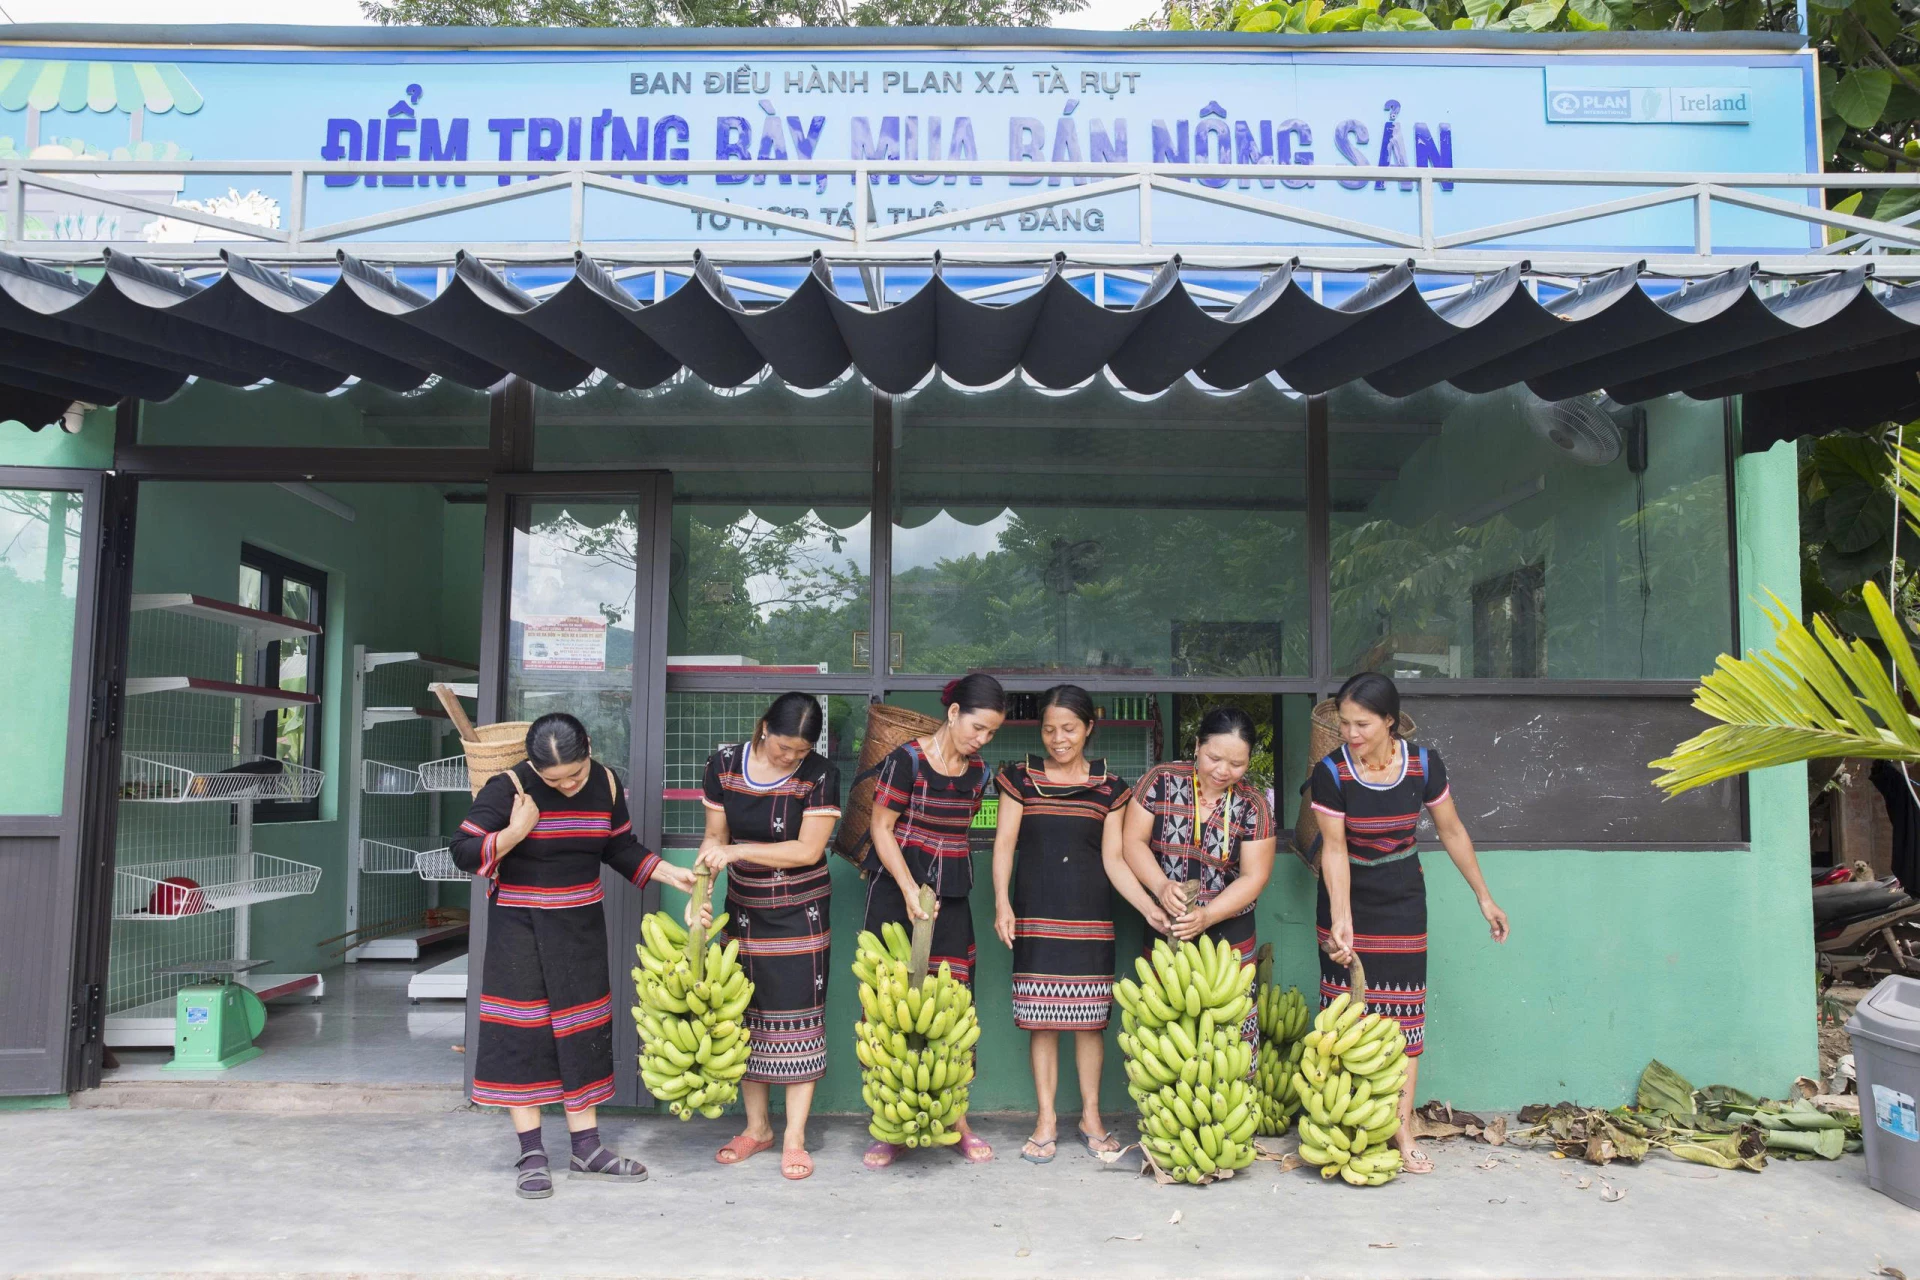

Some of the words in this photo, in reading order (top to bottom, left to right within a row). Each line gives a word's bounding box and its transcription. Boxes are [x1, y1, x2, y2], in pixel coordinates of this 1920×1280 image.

[630, 71, 692, 95] BAN
[704, 64, 771, 95] ĐIỀU
[784, 65, 868, 94] HÀNH
[883, 71, 963, 94] PLAN
[975, 65, 1019, 94] XÃ
[1032, 64, 1070, 94] TÀ
[1081, 71, 1141, 100] RỤT
[1582, 95, 1628, 109] PLAN
[1679, 92, 1747, 112] Ireland
[321, 83, 470, 188] ĐIỂM
[488, 107, 690, 187] TRƯNG
[850, 115, 984, 187] MUA
[1009, 98, 1129, 188] BÁN
[1151, 99, 1316, 189] NÔNG
[1334, 98, 1455, 192] SẢN
